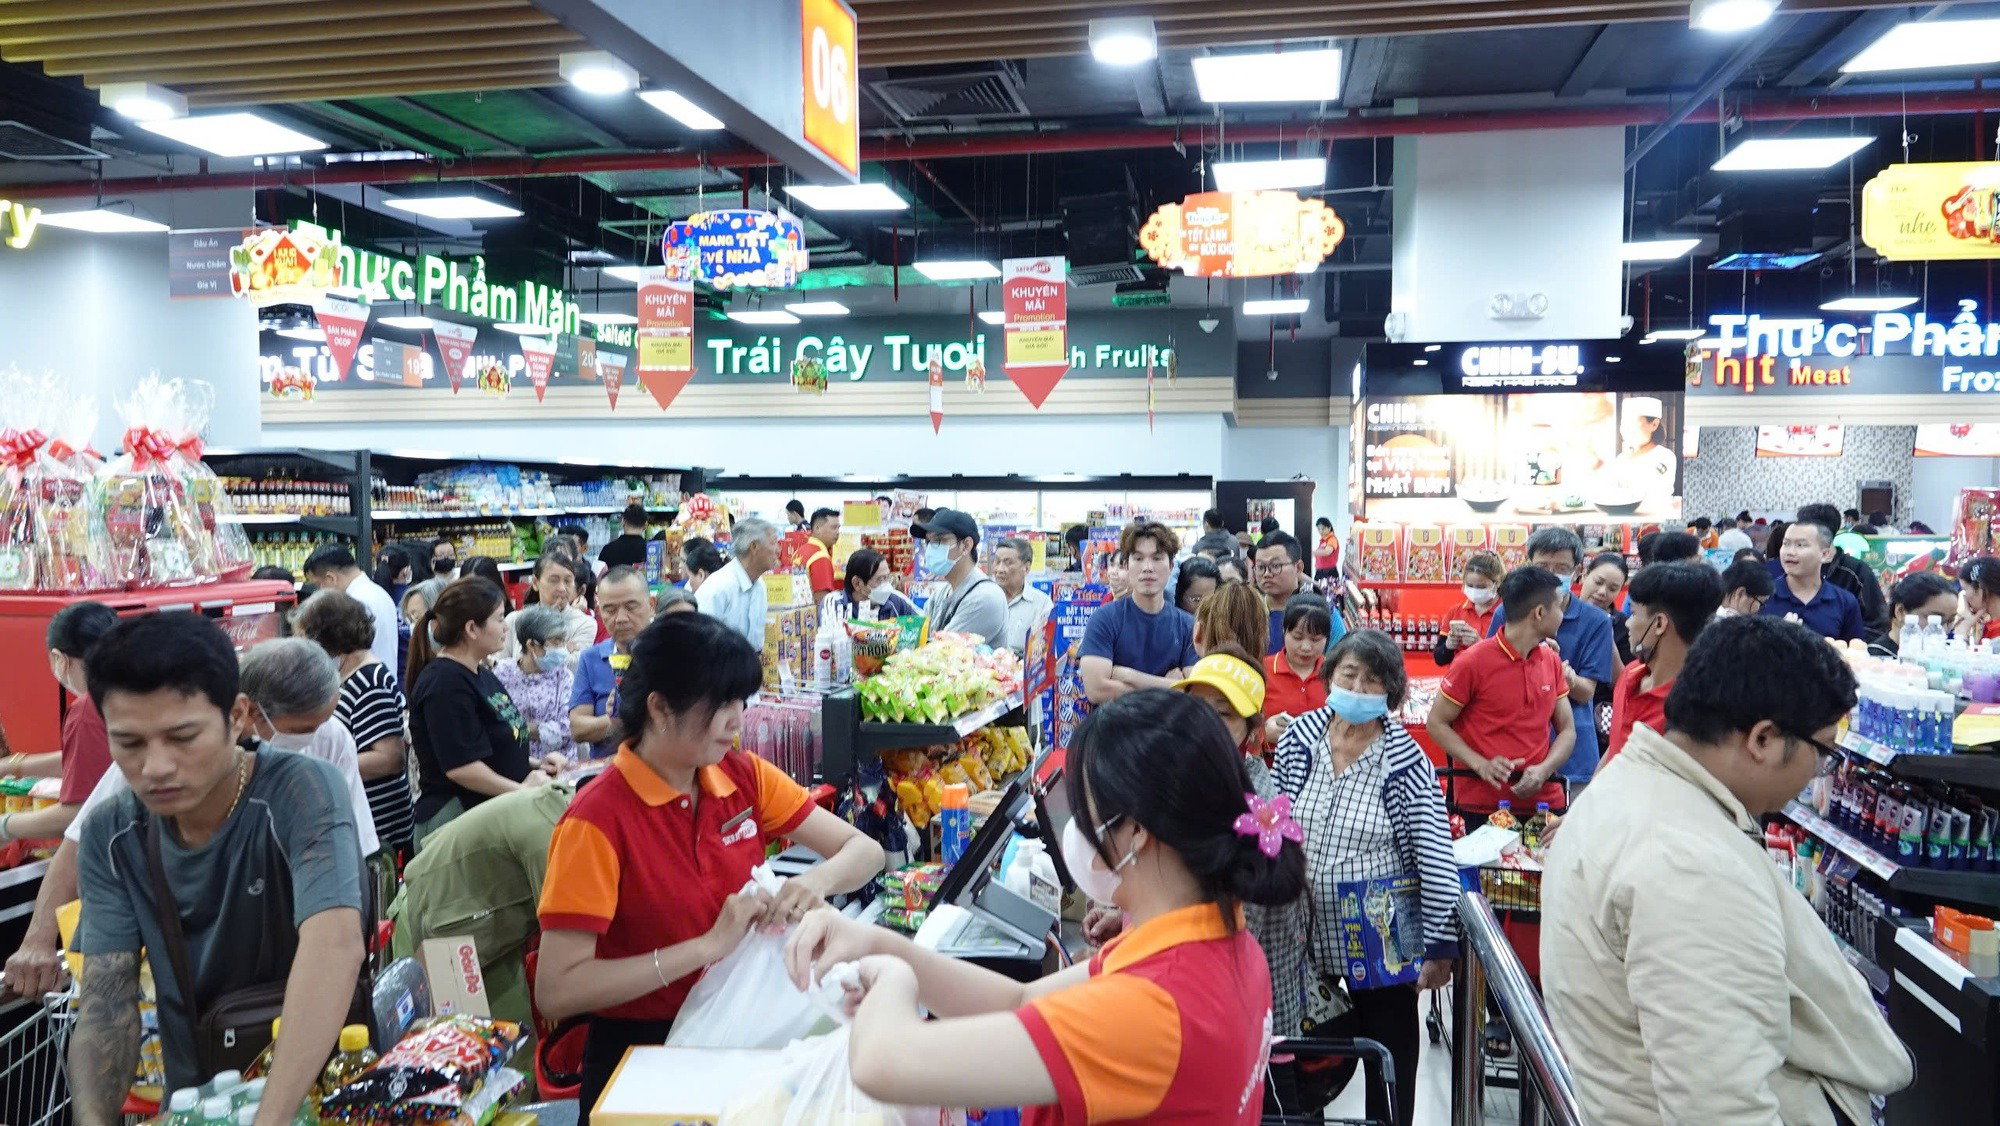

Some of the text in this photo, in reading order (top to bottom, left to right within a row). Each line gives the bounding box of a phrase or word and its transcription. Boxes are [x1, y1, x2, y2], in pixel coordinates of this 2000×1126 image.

[811, 26, 849, 124] 06
[699, 234, 734, 246] MANG
[726, 246, 761, 264] NHÀ
[423, 254, 518, 323] Phẩm
[525, 279, 581, 343] Mặn
[1014, 313, 1055, 323] Promotion
[707, 333, 781, 374] Trái
[796, 335, 873, 381] Cây
[884, 334, 985, 373] Tươi
[1095, 344, 1171, 368] Fruits
[1708, 313, 1857, 368] Thực
[581, 350, 594, 367] 20
[1692, 350, 1851, 393] hịt Meat
